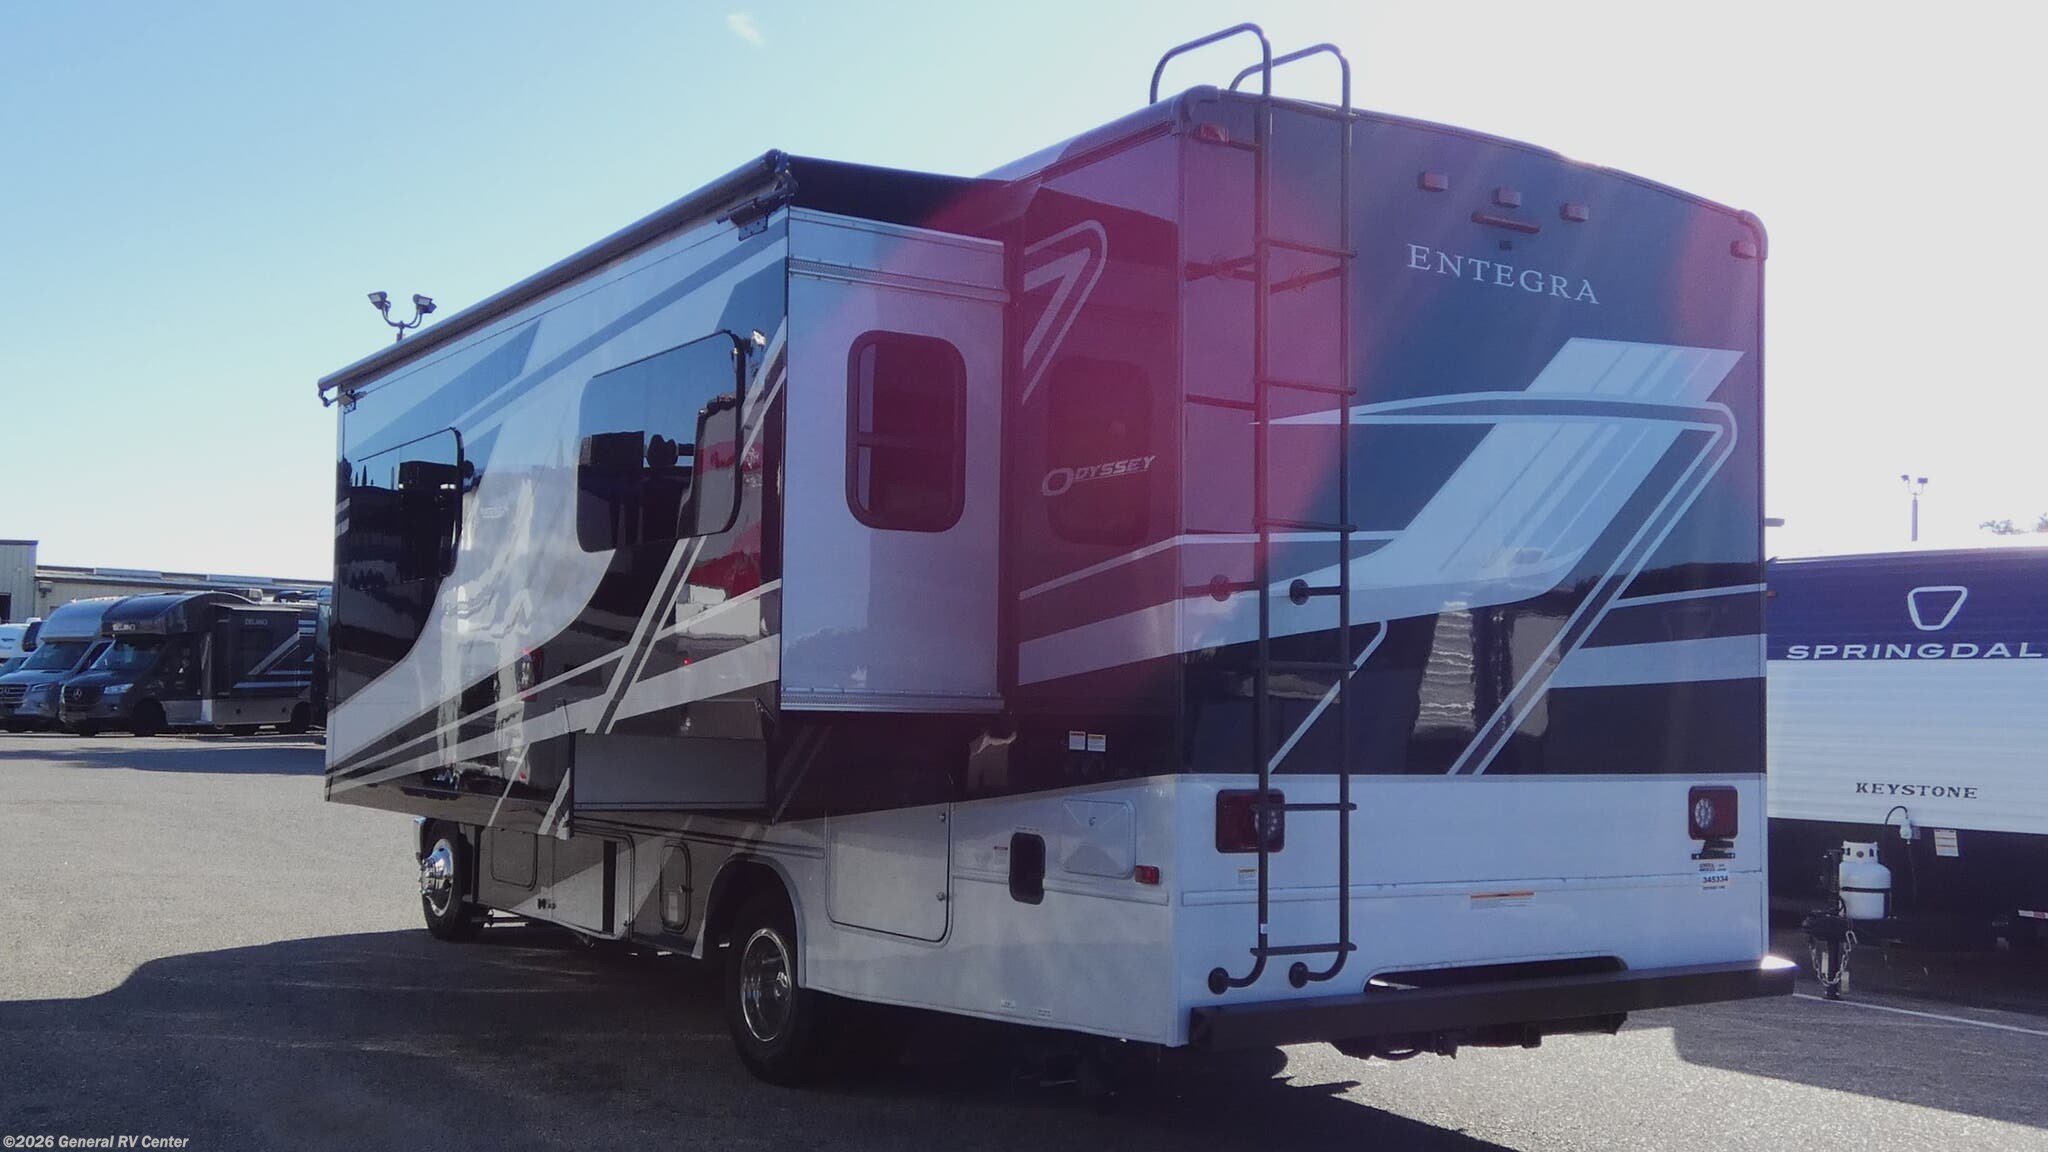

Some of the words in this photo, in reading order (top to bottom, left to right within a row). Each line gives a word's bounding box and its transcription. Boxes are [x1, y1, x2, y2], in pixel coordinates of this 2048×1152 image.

[1407, 243, 1600, 304] ENTEGRA
[1041, 456, 1156, 496] ODYSSEY
[1786, 642, 2043, 660] SPRINGDAL
[1856, 782, 1978, 799] KEYSTONE
